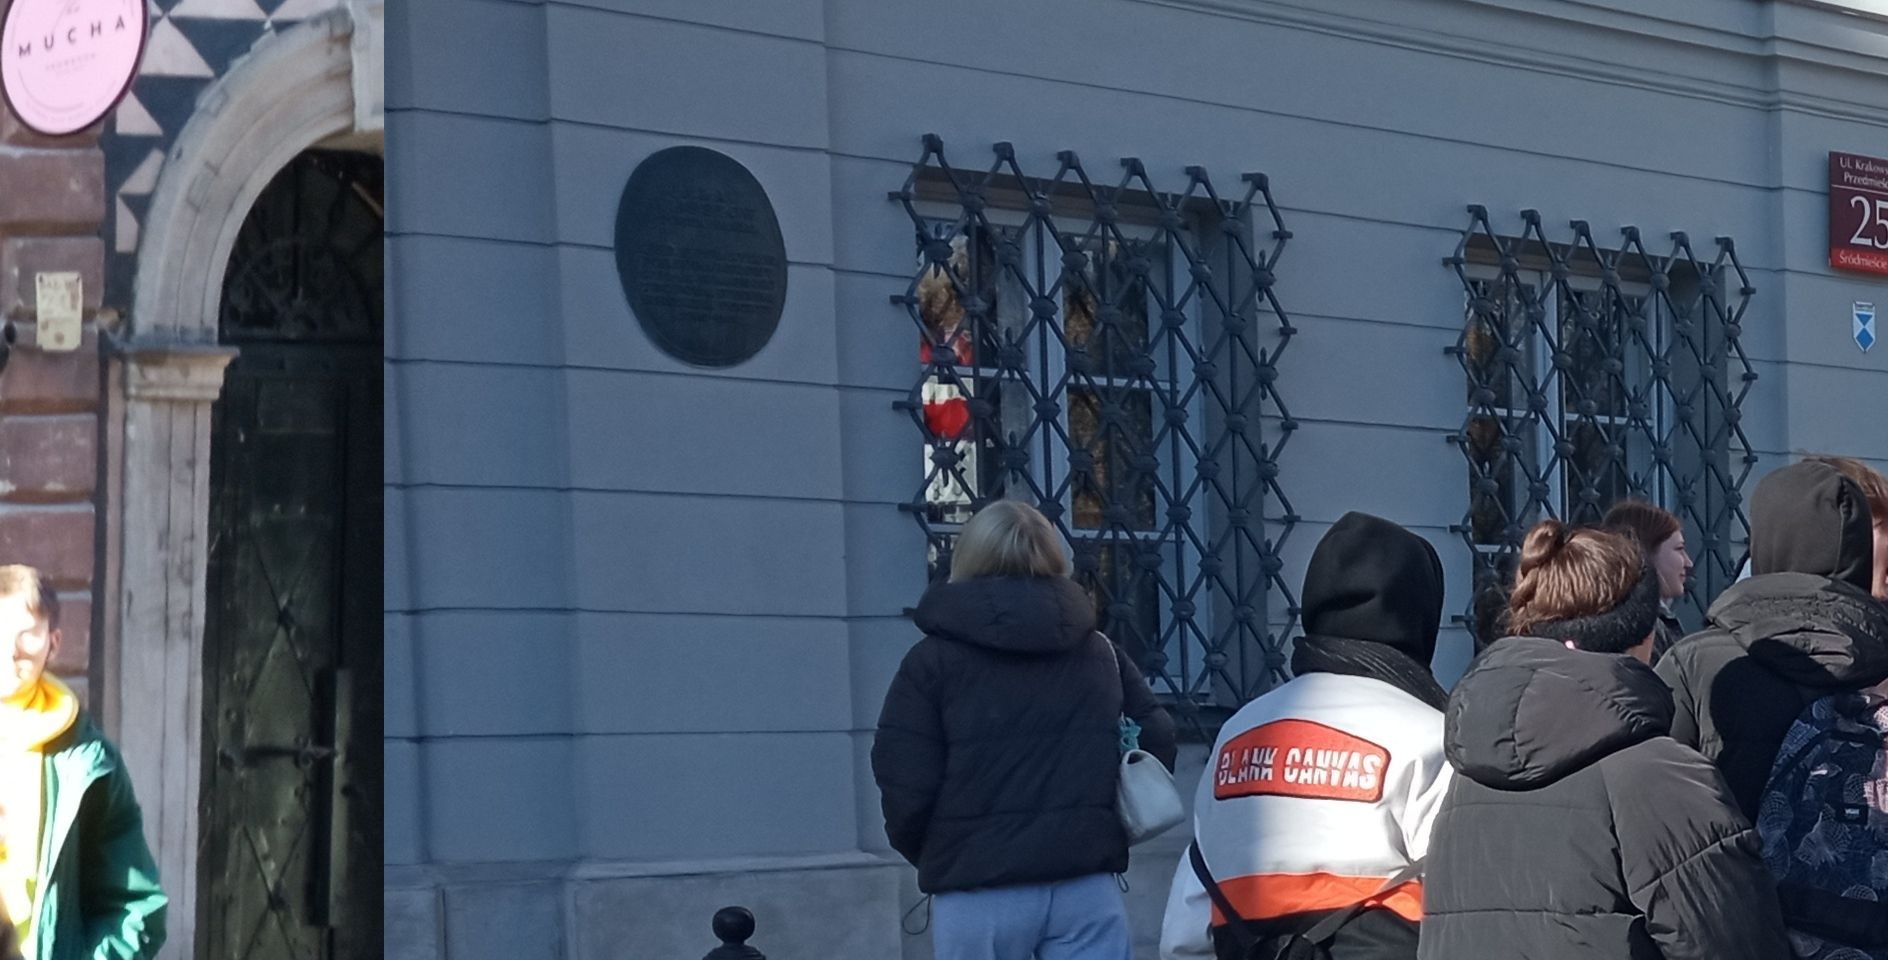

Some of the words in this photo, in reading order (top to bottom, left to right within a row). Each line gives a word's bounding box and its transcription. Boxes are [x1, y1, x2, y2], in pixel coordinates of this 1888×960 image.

[18, 15, 125, 59] MUCHA
[1839, 250, 1888, 270] Śródmieście
[1218, 748, 1278, 786] BLANK
[1283, 748, 1382, 790] CANVAS
